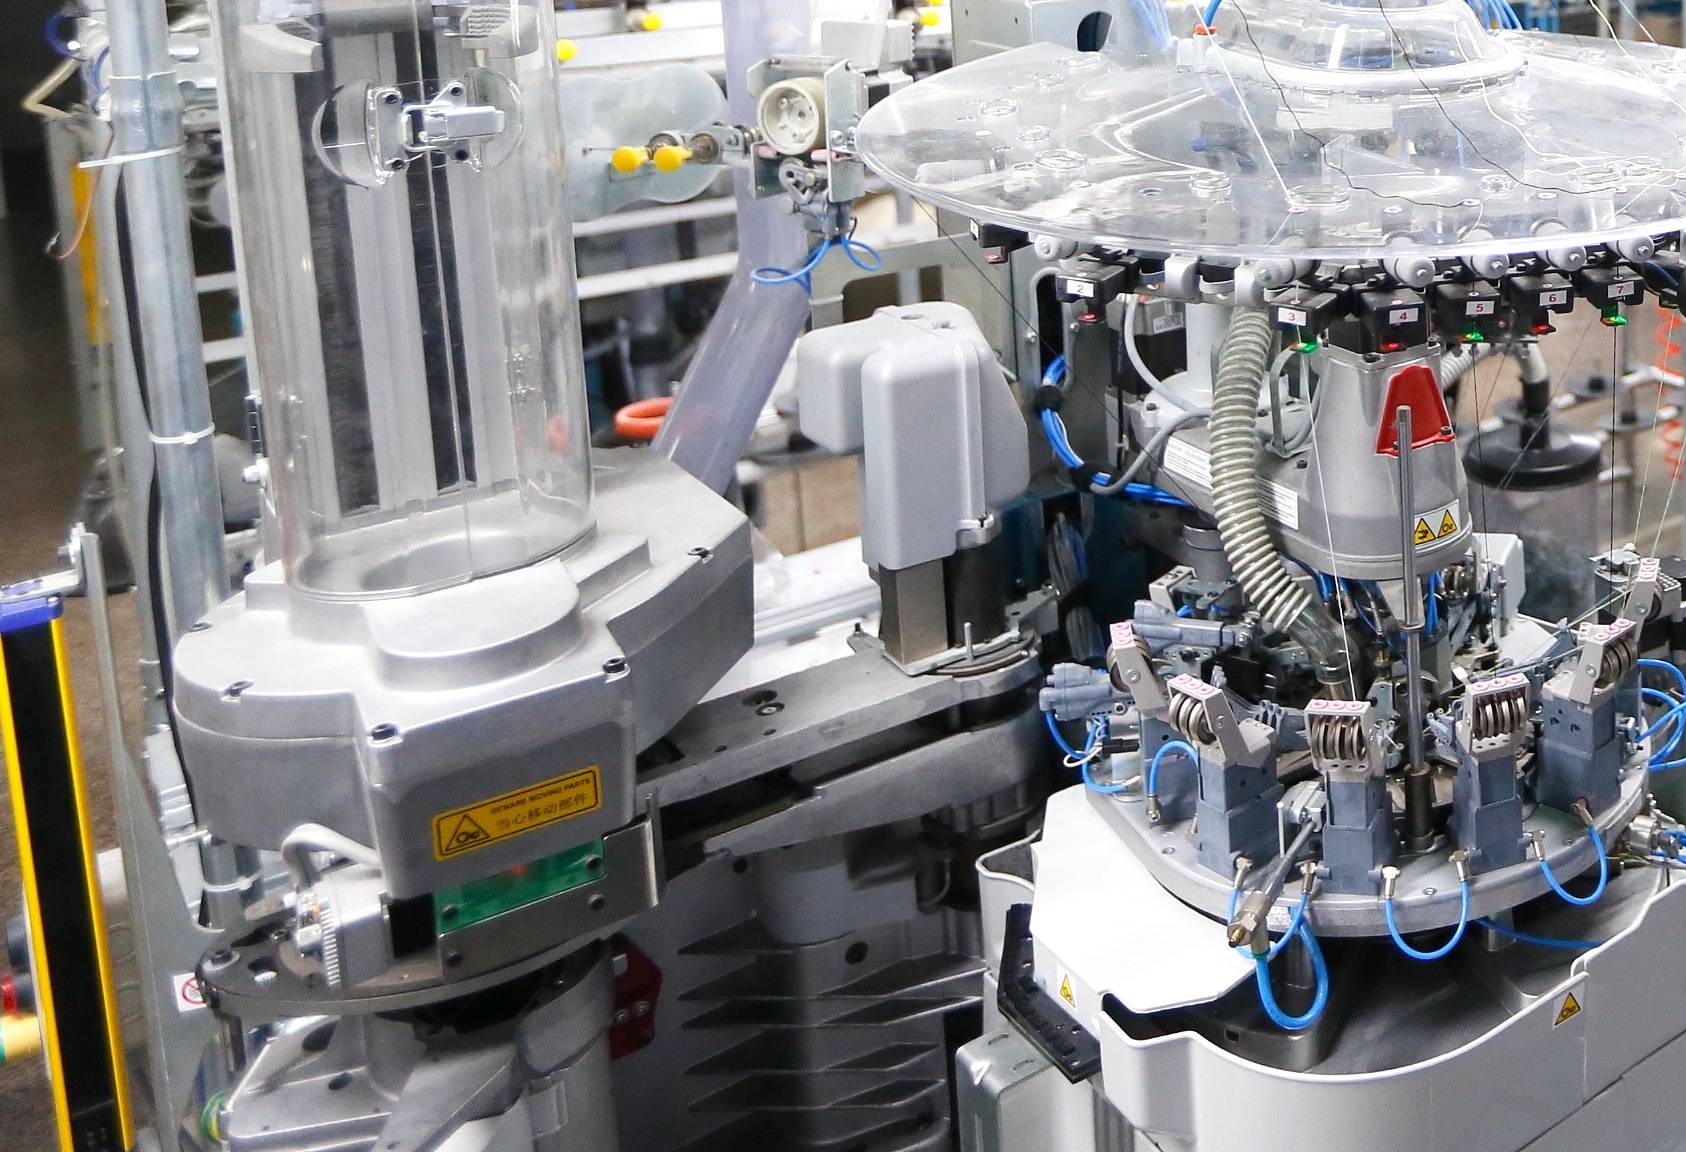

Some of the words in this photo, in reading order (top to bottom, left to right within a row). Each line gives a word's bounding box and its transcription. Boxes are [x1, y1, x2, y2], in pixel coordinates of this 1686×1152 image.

[1076, 285, 1084, 294] 2
[1616, 285, 1624, 294] 7
[1549, 293, 1557, 303] 6
[1475, 303, 1484, 313] 5
[1288, 312, 1296, 322] 3
[1399, 311, 1407, 321] 4
[528, 787, 562, 802] MOVING
[564, 778, 591, 791] PARTS
